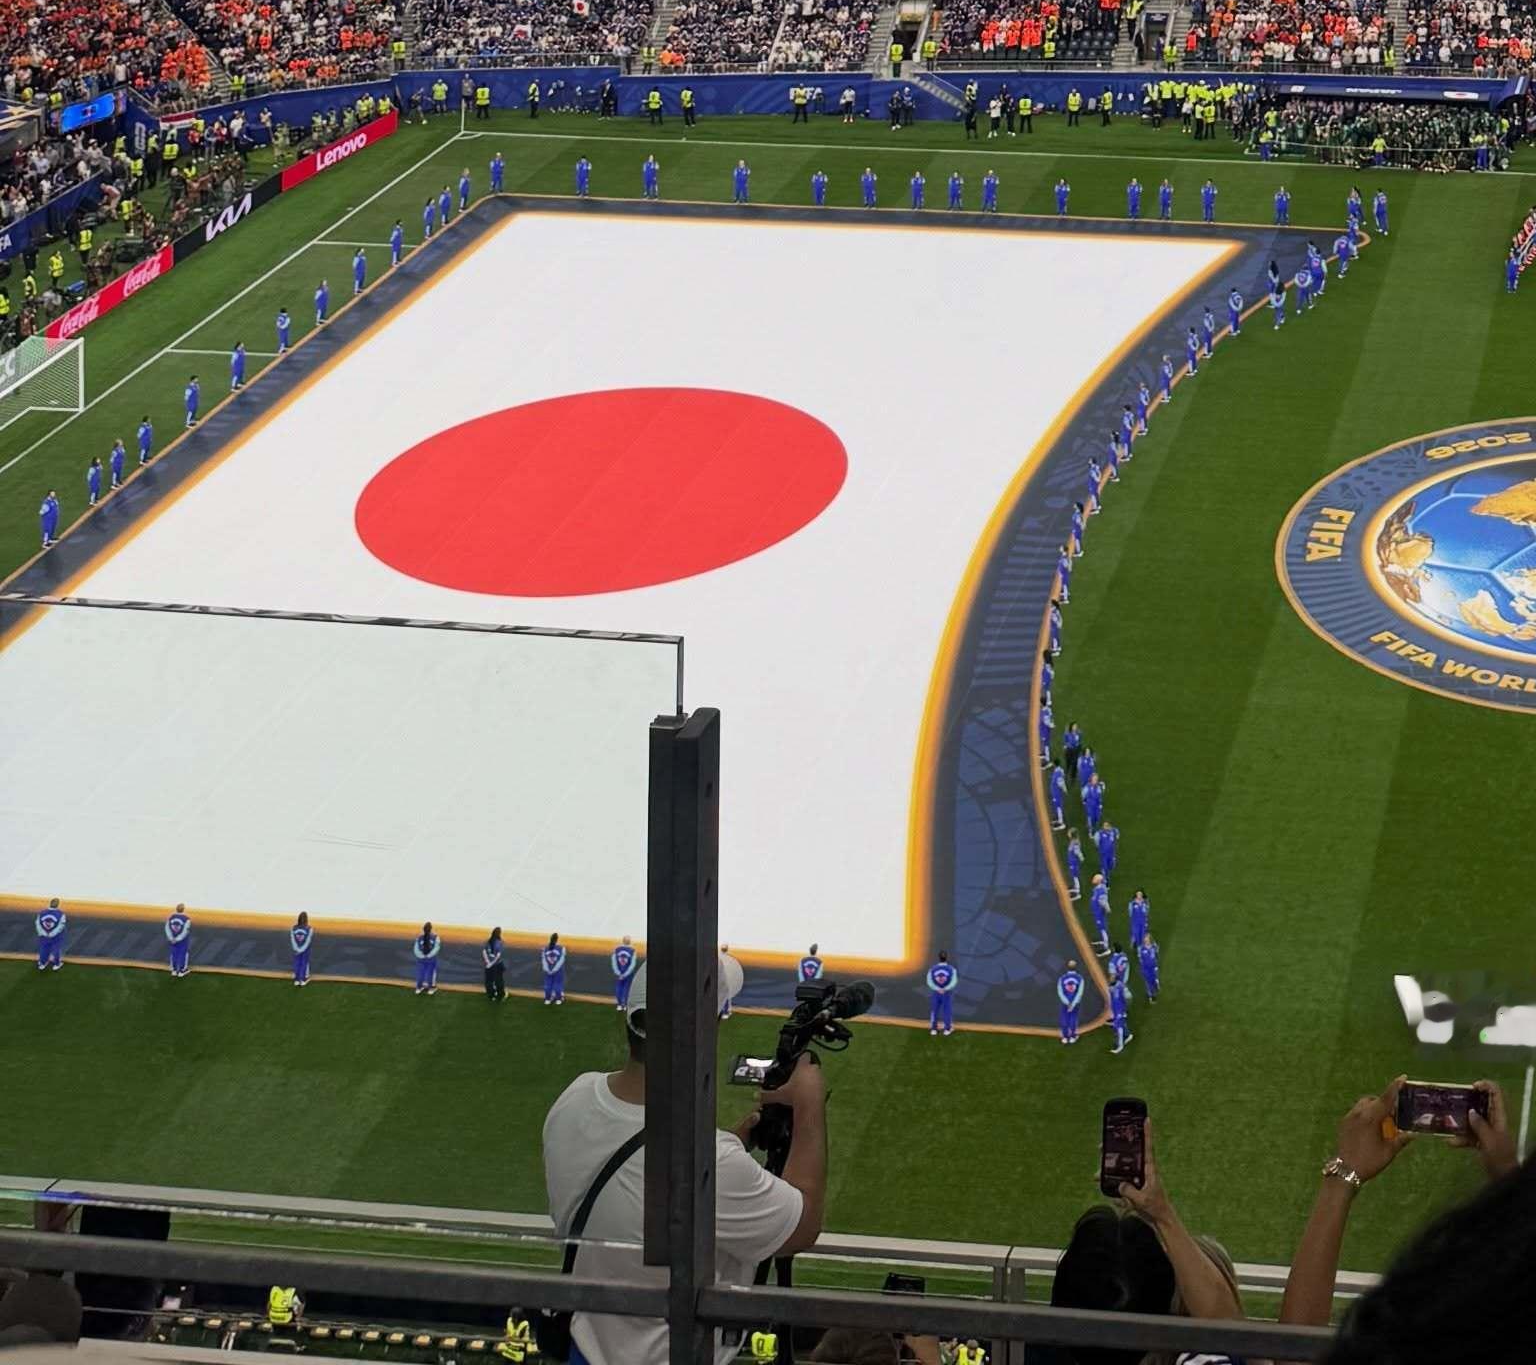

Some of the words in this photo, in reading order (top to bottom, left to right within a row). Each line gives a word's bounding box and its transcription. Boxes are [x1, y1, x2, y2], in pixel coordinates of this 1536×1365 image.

[316, 133, 367, 171] Lenovo
[206, 193, 252, 242] KIA
[1425, 432, 1533, 460] 2026
[1305, 507, 1356, 562] FIFA
[1370, 630, 1438, 668] FIFA
